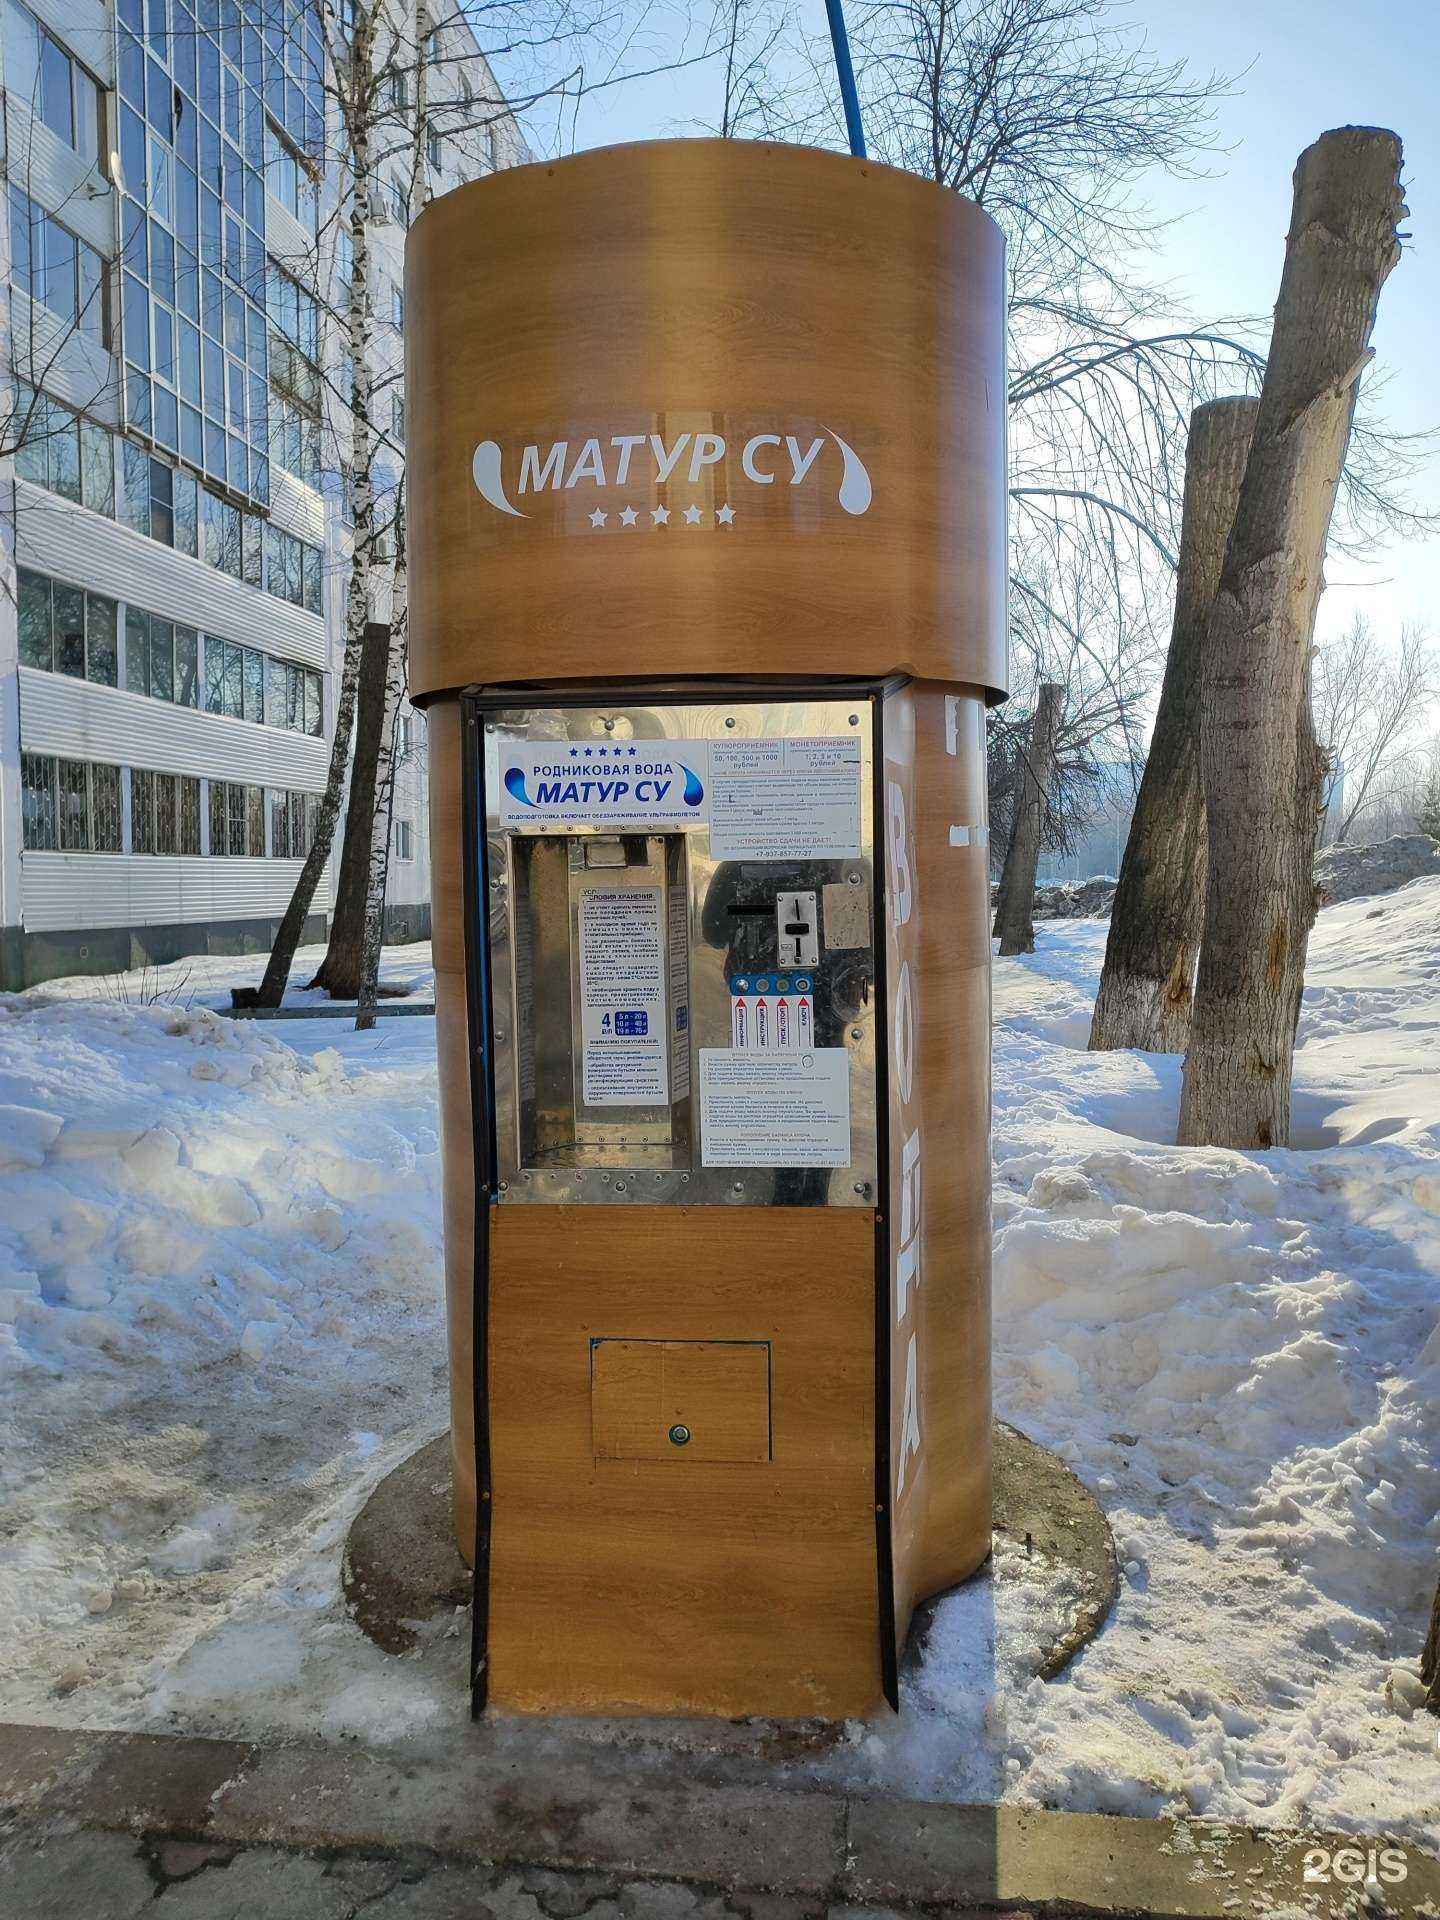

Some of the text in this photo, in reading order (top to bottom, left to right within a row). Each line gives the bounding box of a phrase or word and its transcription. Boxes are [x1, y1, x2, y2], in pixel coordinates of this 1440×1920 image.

[517, 433, 825, 495] МАТУР СУ
[533, 763, 673, 778] РОДНИКОВАЯ ВОДА
[536, 780, 672, 803] МАТУР СУ
[601, 1012, 611, 1028] 4
[779, 1007, 787, 1045] ПУСК/СТОП
